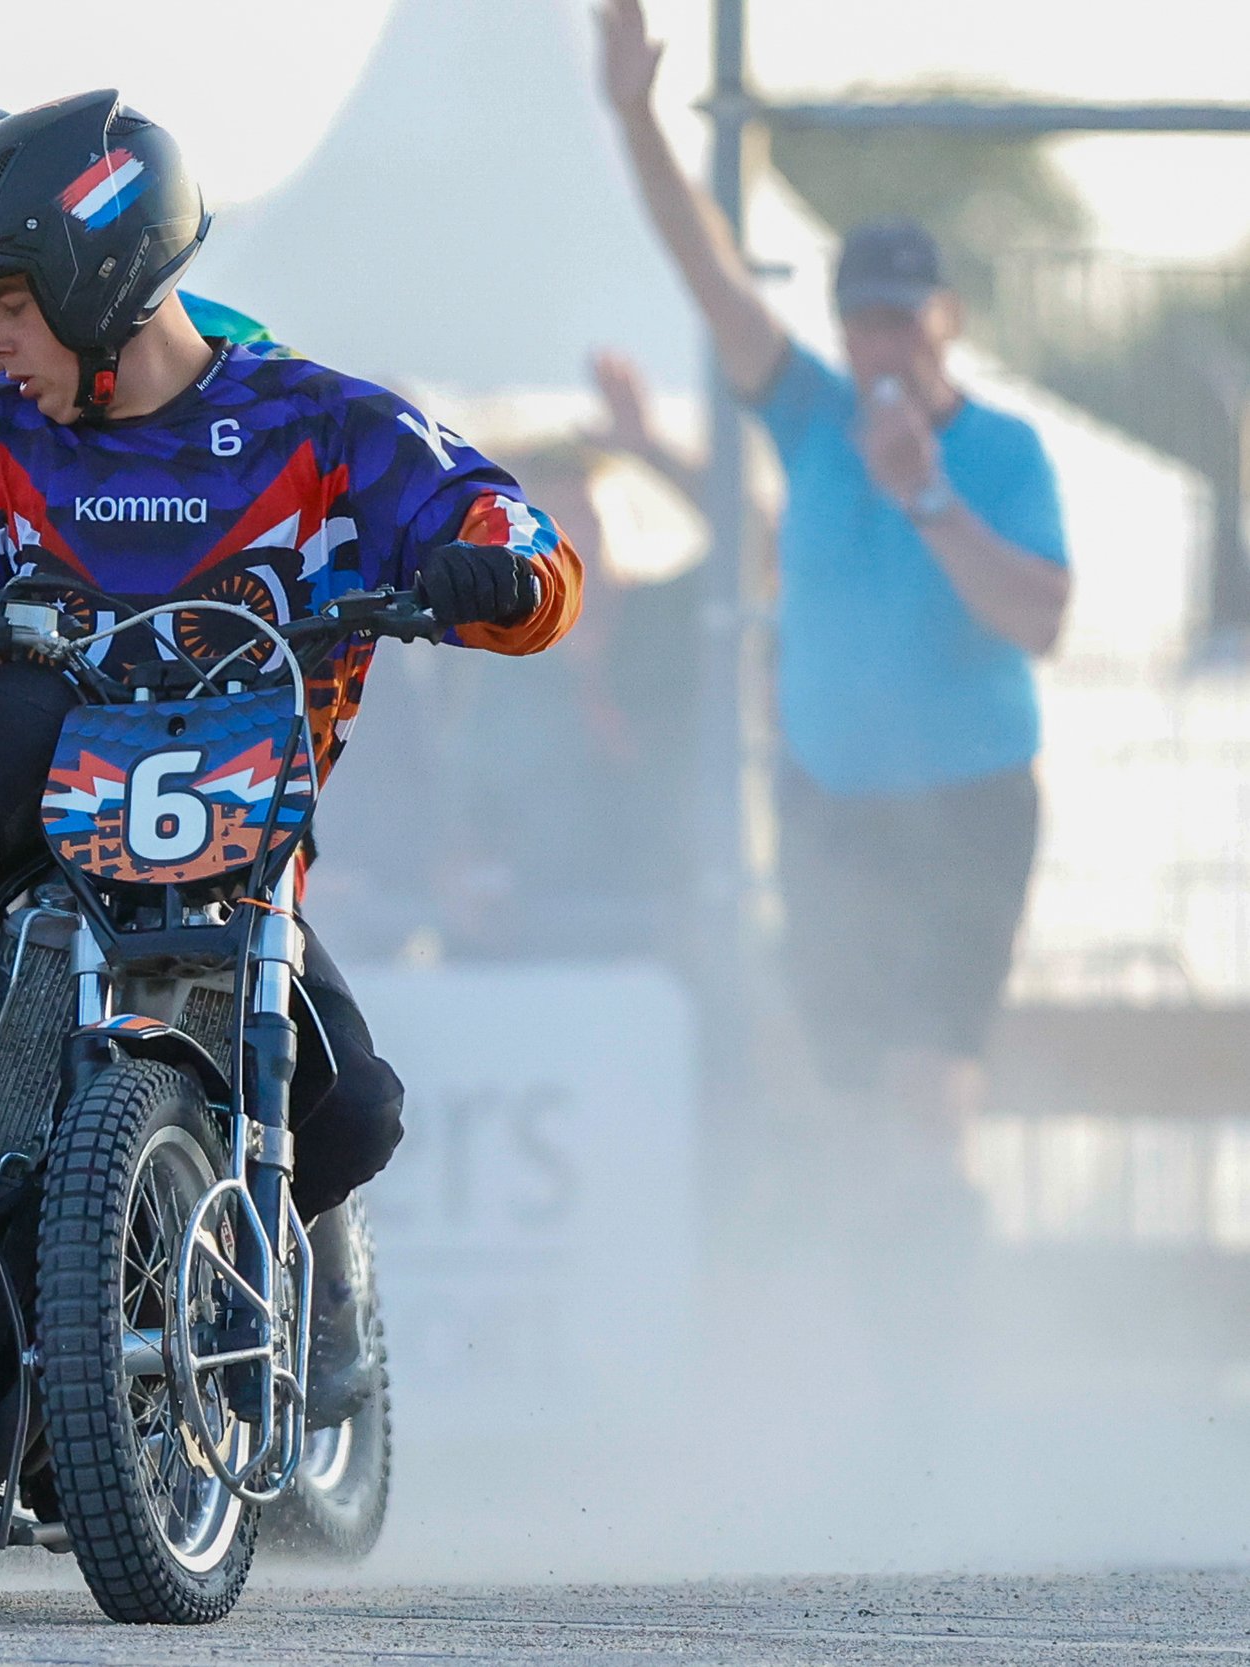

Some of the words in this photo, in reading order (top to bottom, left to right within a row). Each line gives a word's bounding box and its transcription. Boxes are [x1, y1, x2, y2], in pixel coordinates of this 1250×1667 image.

[114, 233, 150, 308] HELMETS
[210, 418, 243, 457] 6
[128, 750, 209, 861] 6
